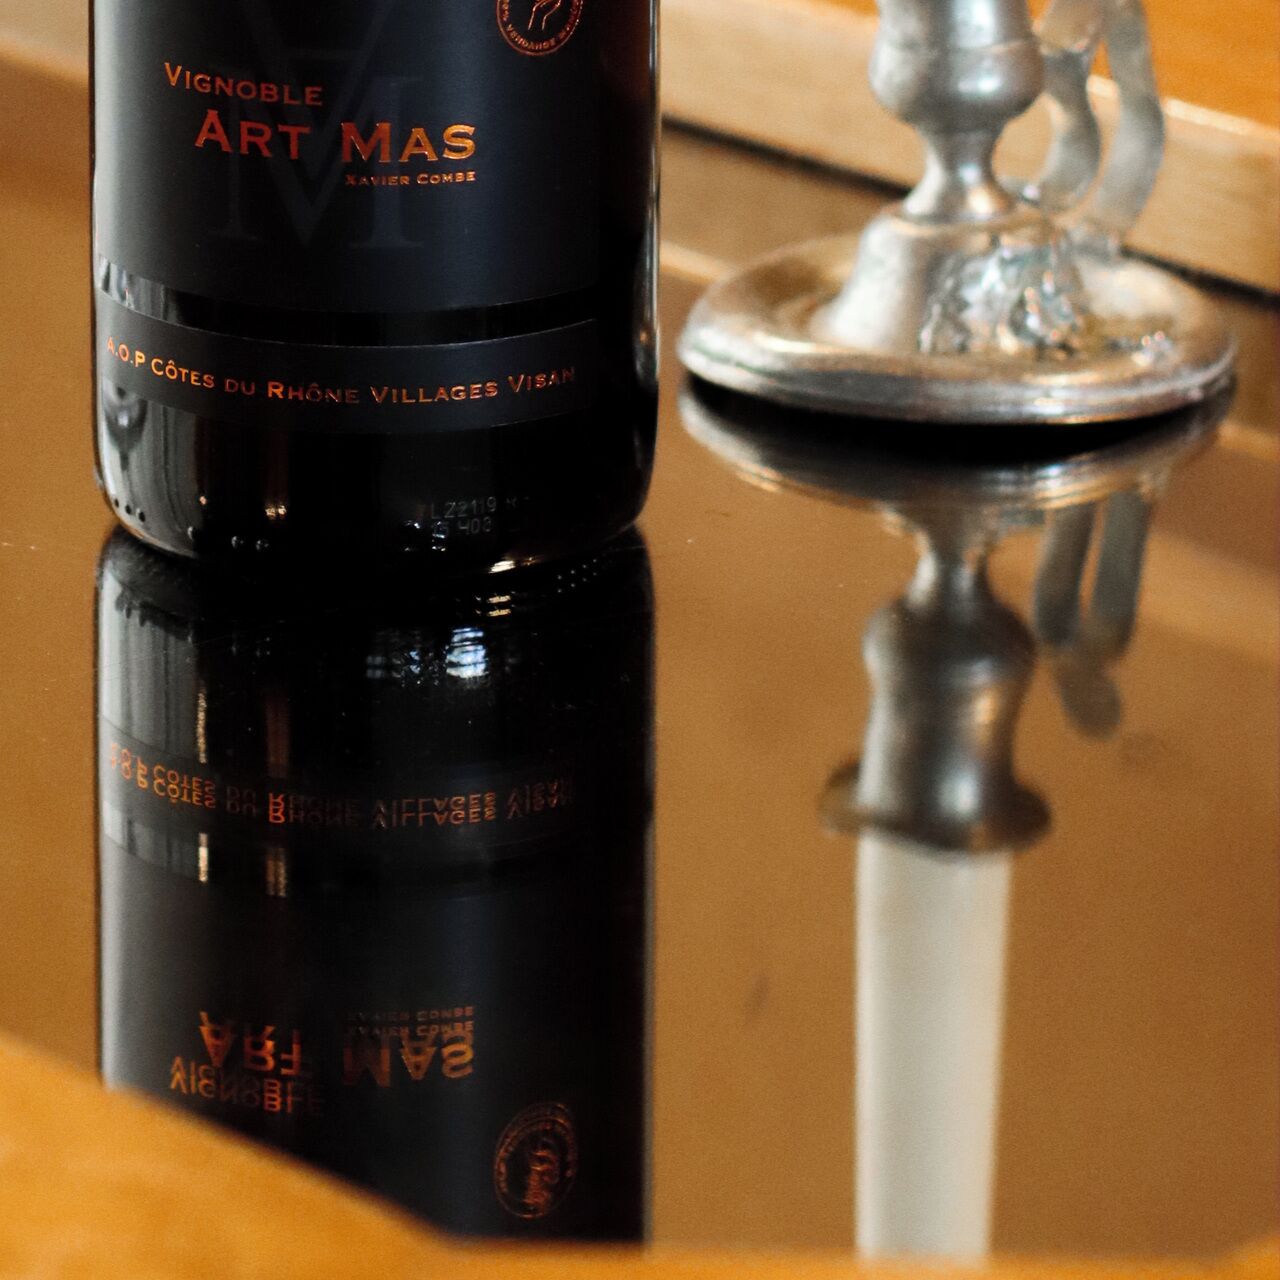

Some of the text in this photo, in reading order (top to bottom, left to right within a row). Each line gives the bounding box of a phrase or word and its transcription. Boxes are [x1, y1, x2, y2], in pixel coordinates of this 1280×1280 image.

[164, 61, 324, 107] VIGNOBLE
[194, 107, 477, 165] ART MAS
[345, 170, 477, 187] XAVIER COMBE
[107, 336, 577, 405] A.O.P CÔTES DU RHÔNE VILLAGES VISAN
